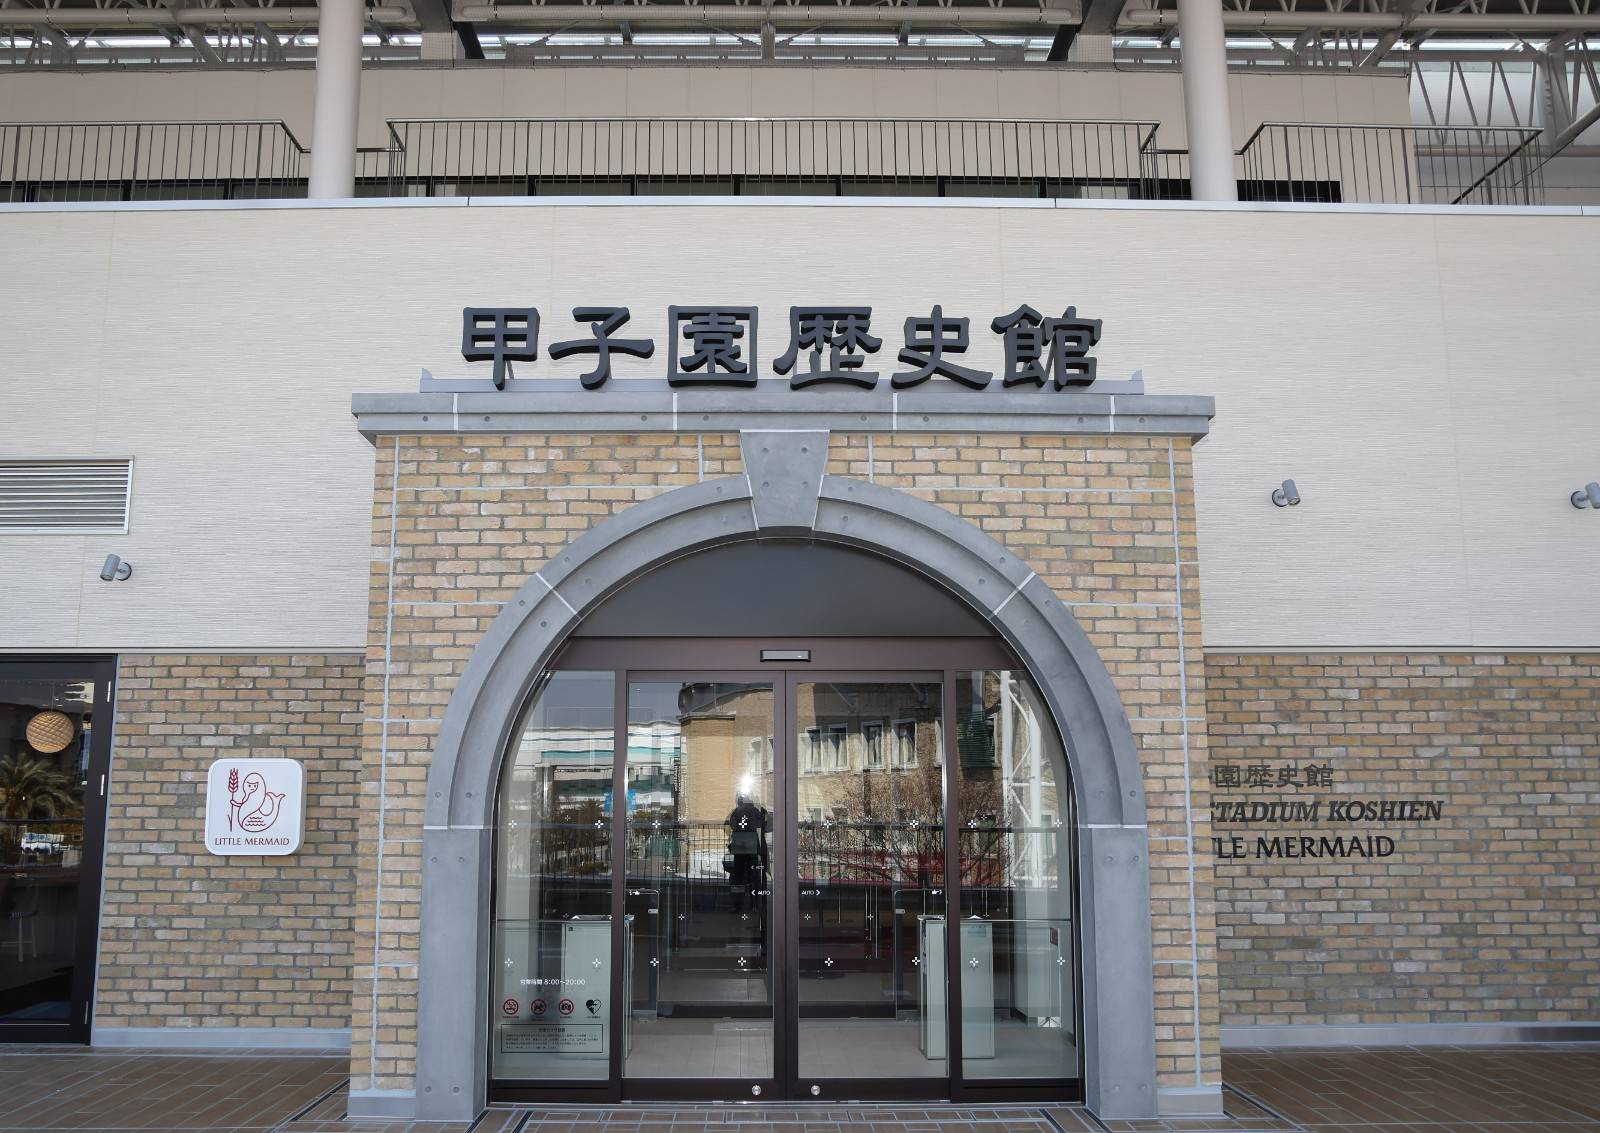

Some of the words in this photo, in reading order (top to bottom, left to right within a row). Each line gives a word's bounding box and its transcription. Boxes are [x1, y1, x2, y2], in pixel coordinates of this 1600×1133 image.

[461, 304, 1102, 391] 甲子園歴史館
[1208, 763, 1334, 788] 園歴史館
[1326, 800, 1444, 822] KOSHIEN
[1256, 835, 1395, 858] MERMAID
